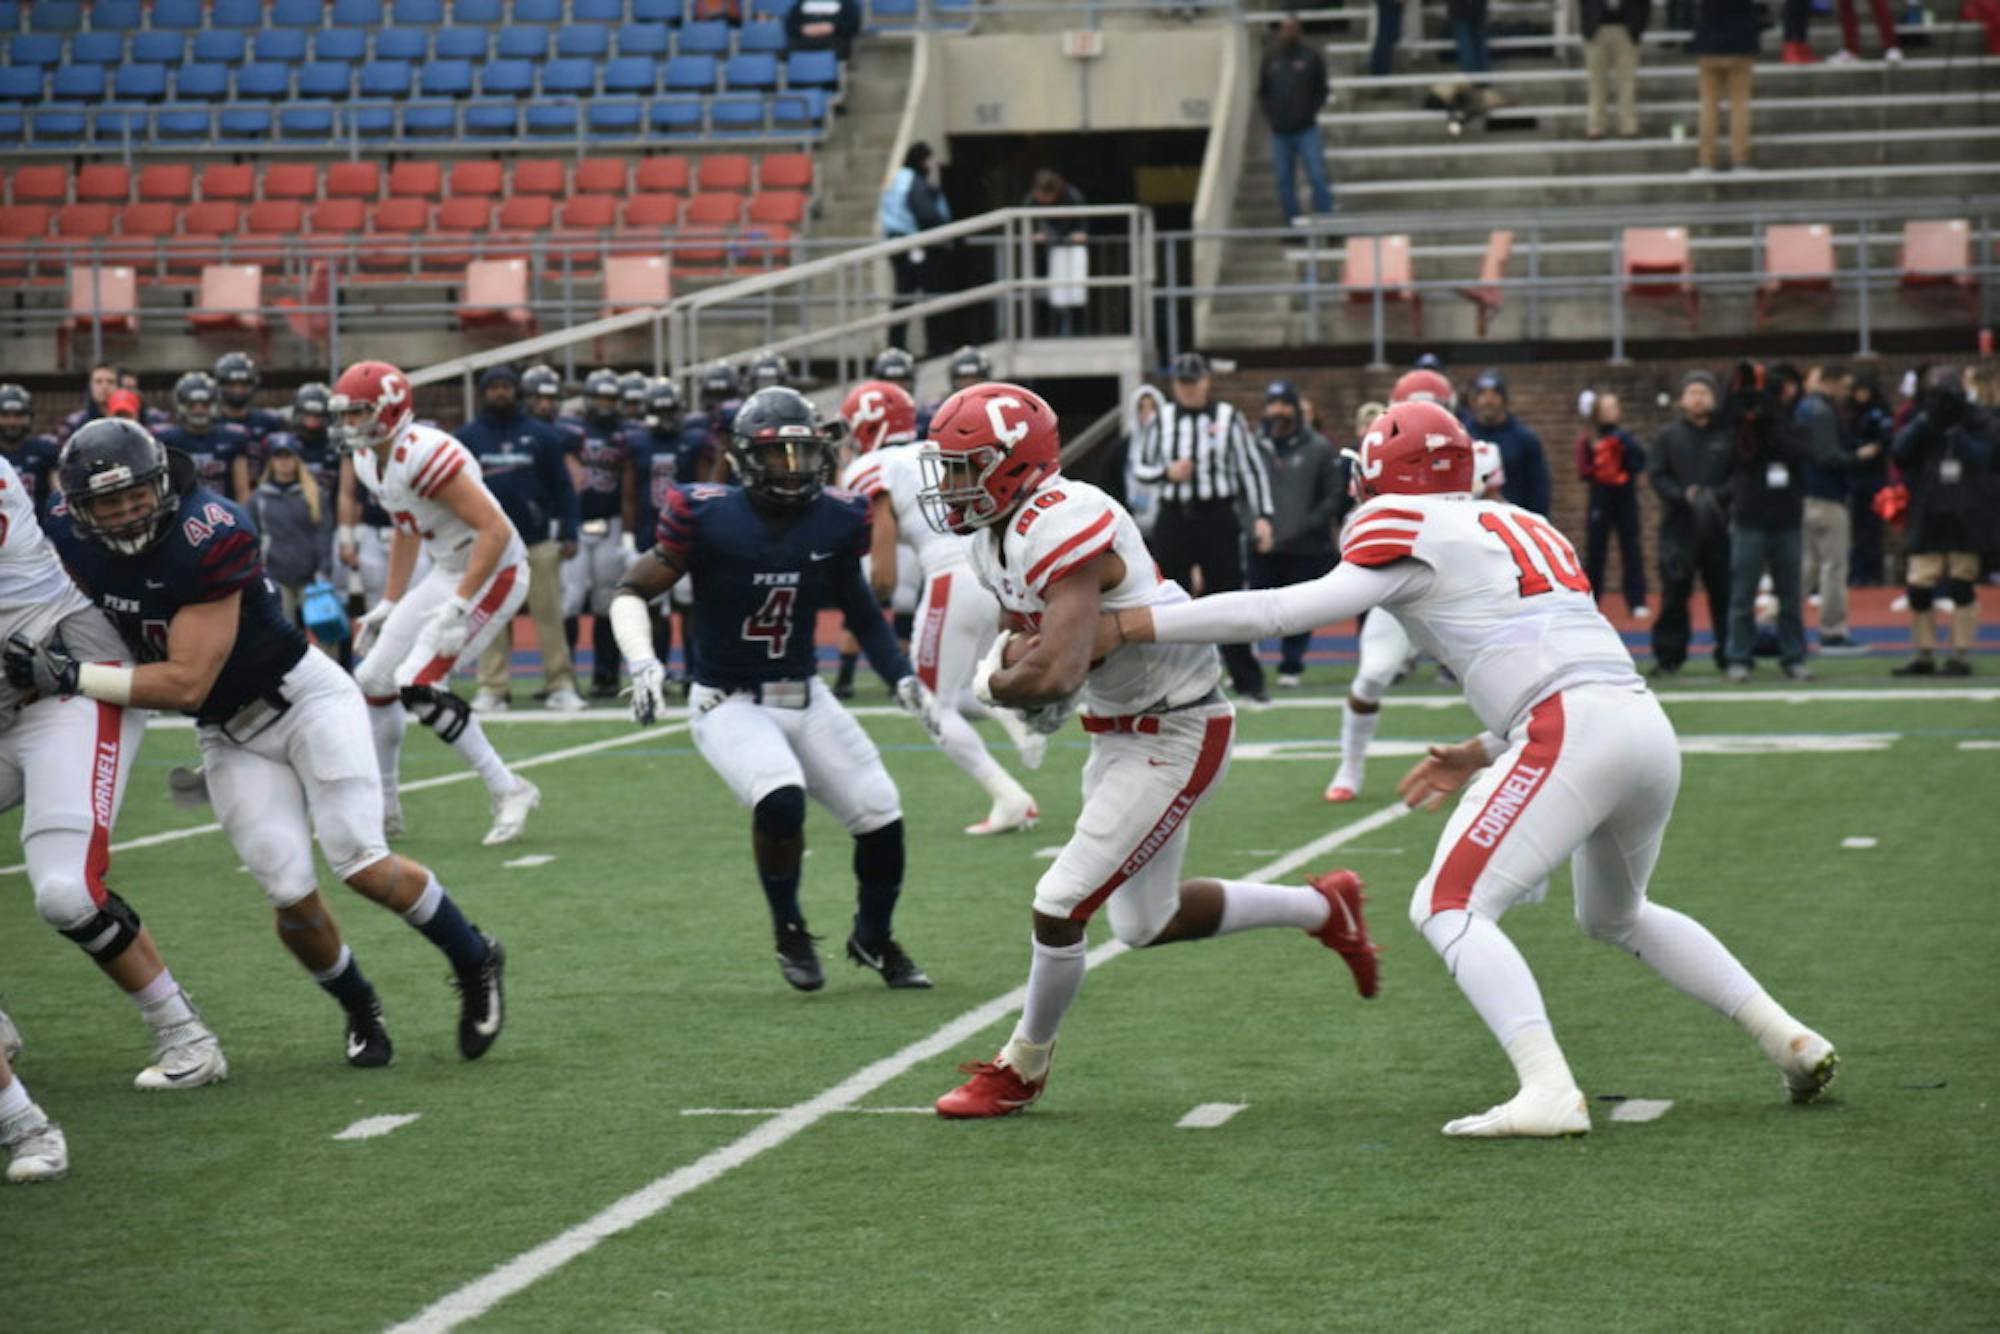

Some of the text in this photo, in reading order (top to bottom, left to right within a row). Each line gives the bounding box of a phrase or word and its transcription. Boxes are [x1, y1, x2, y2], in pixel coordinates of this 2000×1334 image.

[381, 374, 405, 403] C
[860, 391, 885, 420] C
[985, 396, 1028, 446] C
[1361, 432, 1383, 479] C
[183, 503, 236, 547] 44
[752, 573, 800, 585] PENN
[1478, 511, 1592, 599] 10
[103, 593, 140, 613] PENN
[741, 587, 797, 659] 4
[96, 740, 118, 827] CORNELL
[1467, 764, 1546, 848] CORNELL
[1121, 796, 1194, 876] CORNELL
